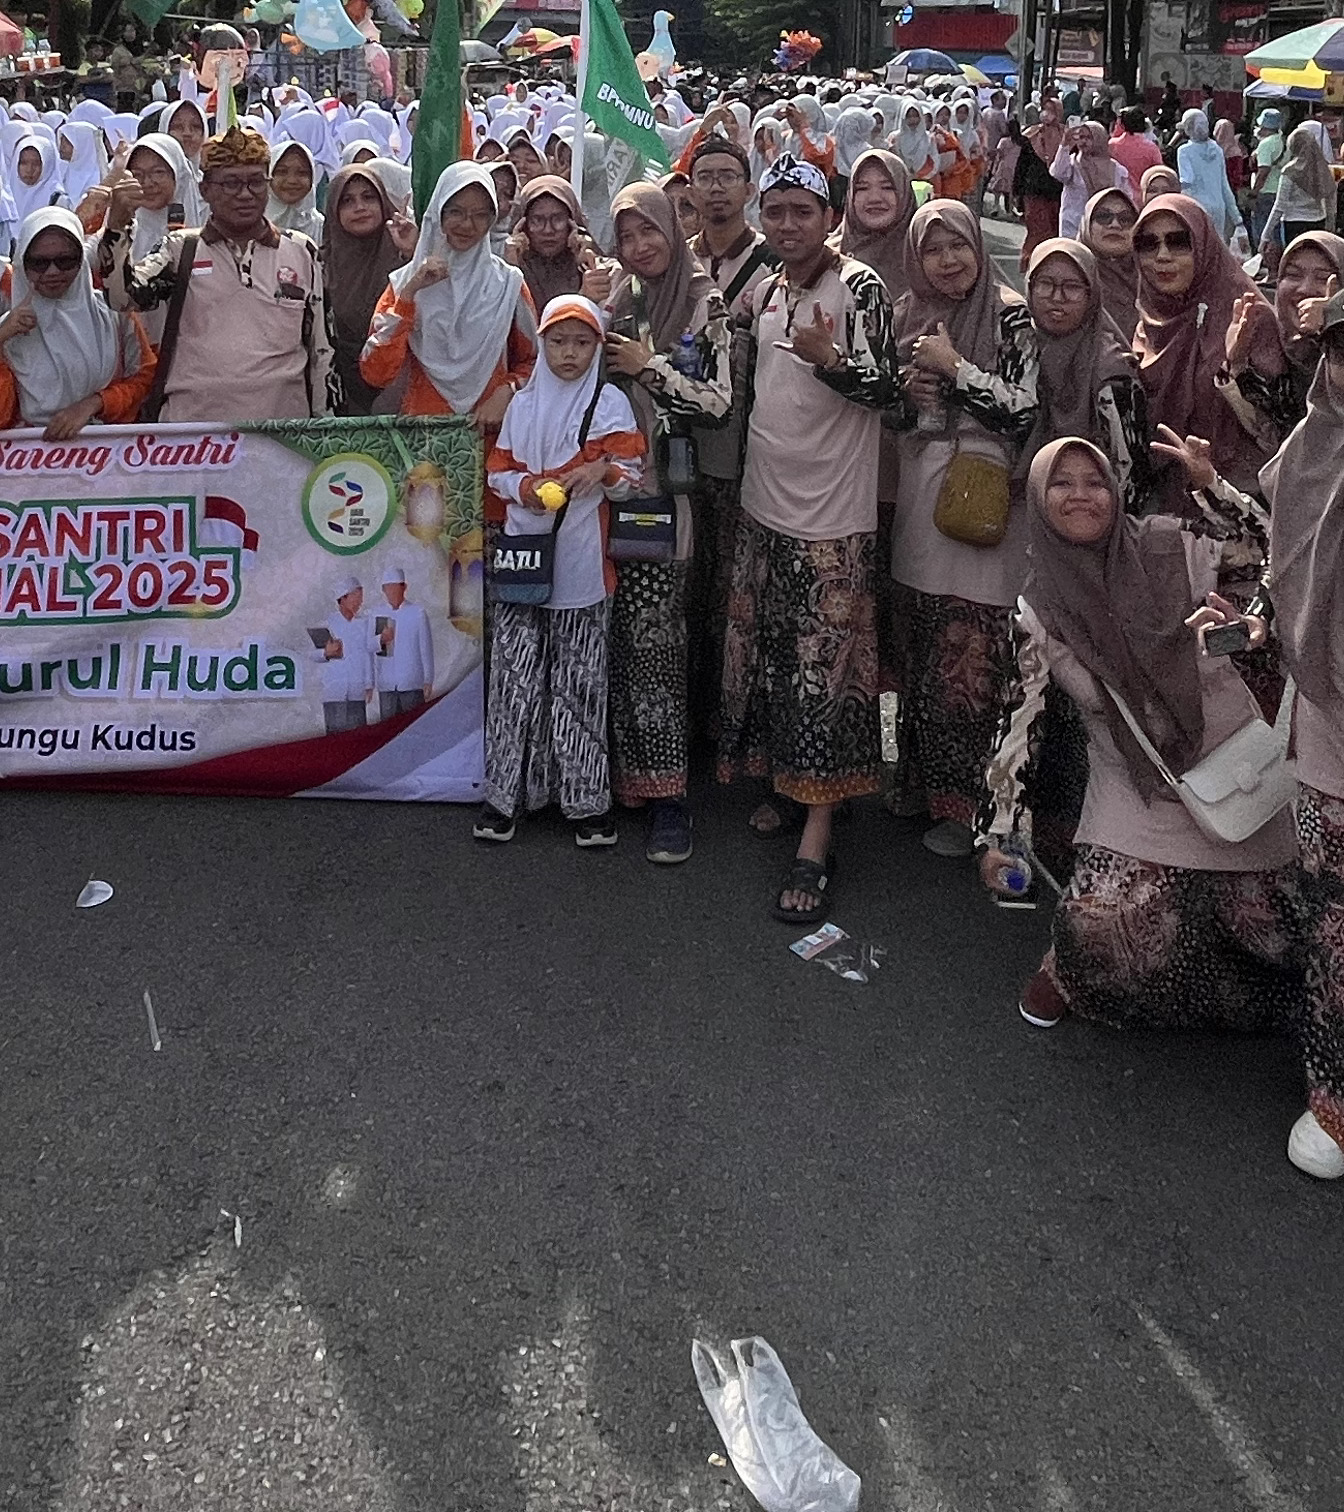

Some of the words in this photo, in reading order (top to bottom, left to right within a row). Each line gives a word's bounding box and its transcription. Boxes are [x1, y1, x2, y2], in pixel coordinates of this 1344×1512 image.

[123, 432, 240, 468] Santri
[92, 560, 232, 610] 2025
[143, 642, 297, 693] Huda
[91, 723, 197, 752] Kudus
